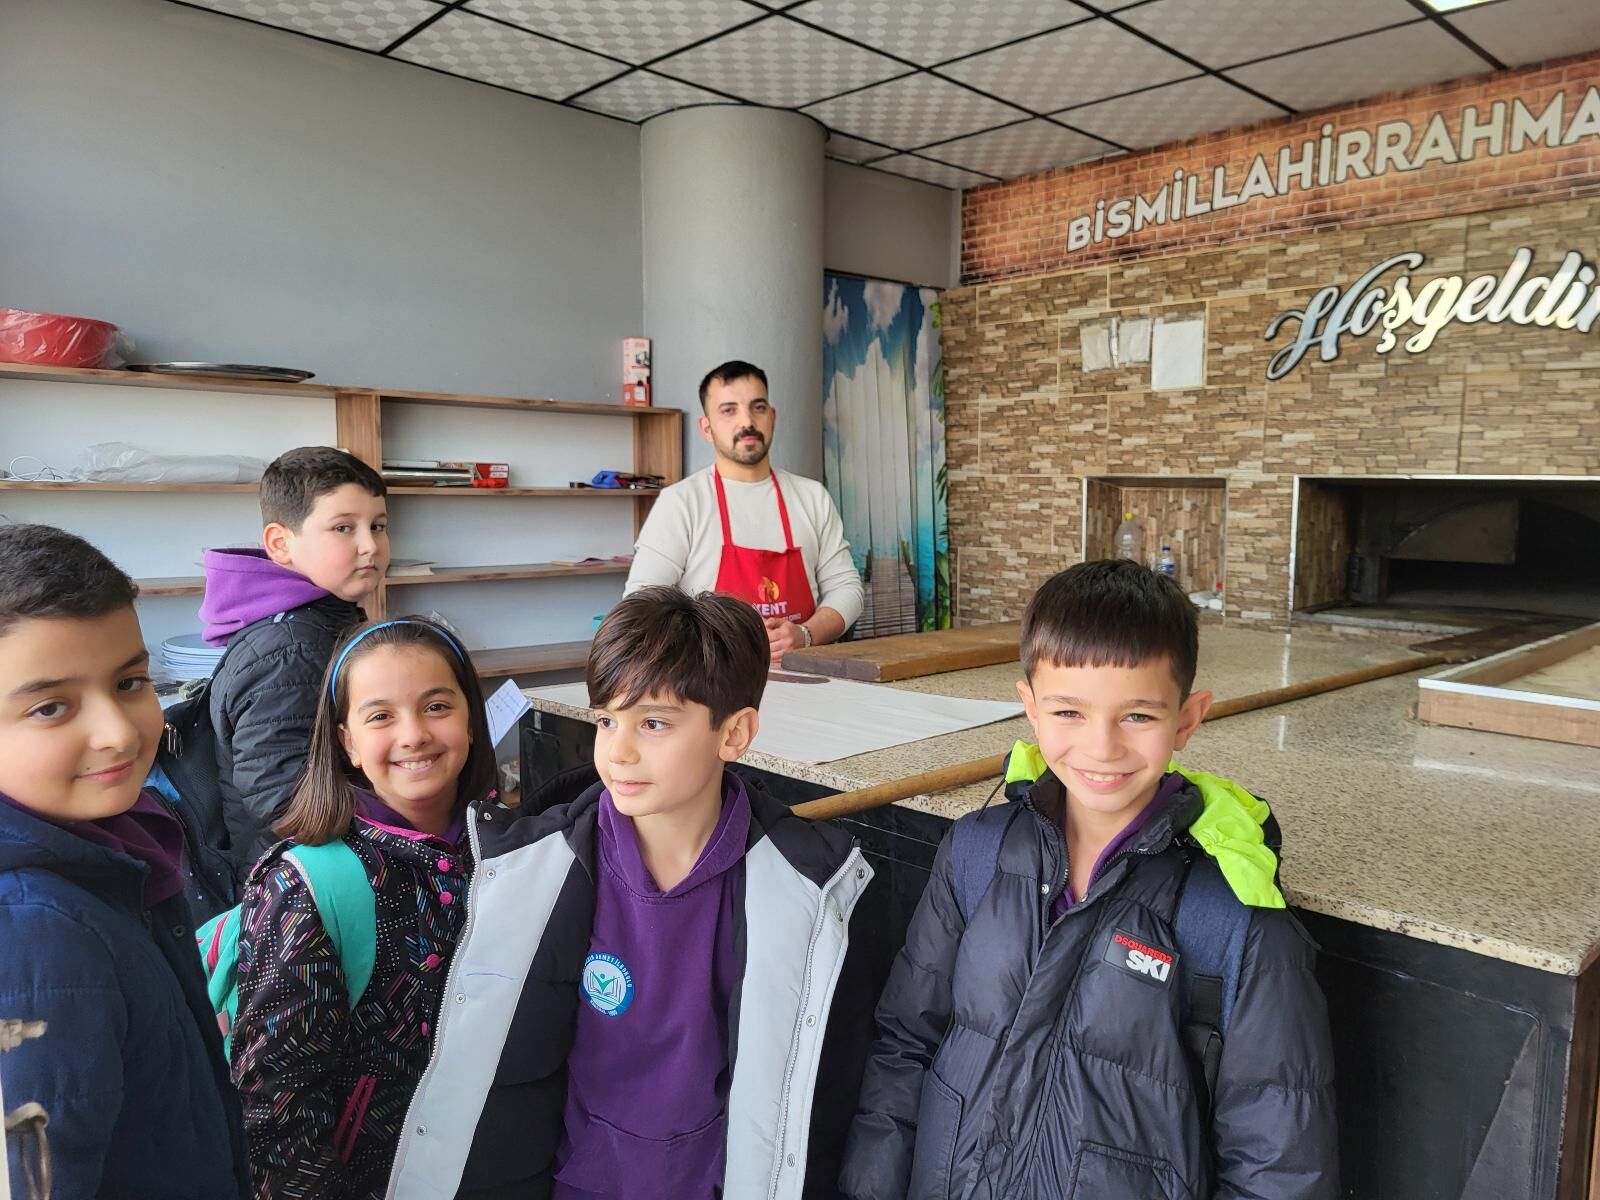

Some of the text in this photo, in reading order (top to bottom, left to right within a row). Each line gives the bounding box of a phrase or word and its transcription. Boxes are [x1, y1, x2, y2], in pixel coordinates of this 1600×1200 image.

[1264, 247, 1600, 380] Hoşgeldi
[1114, 934, 1173, 964] DSQUARED2
[1126, 949, 1171, 982] SKI
